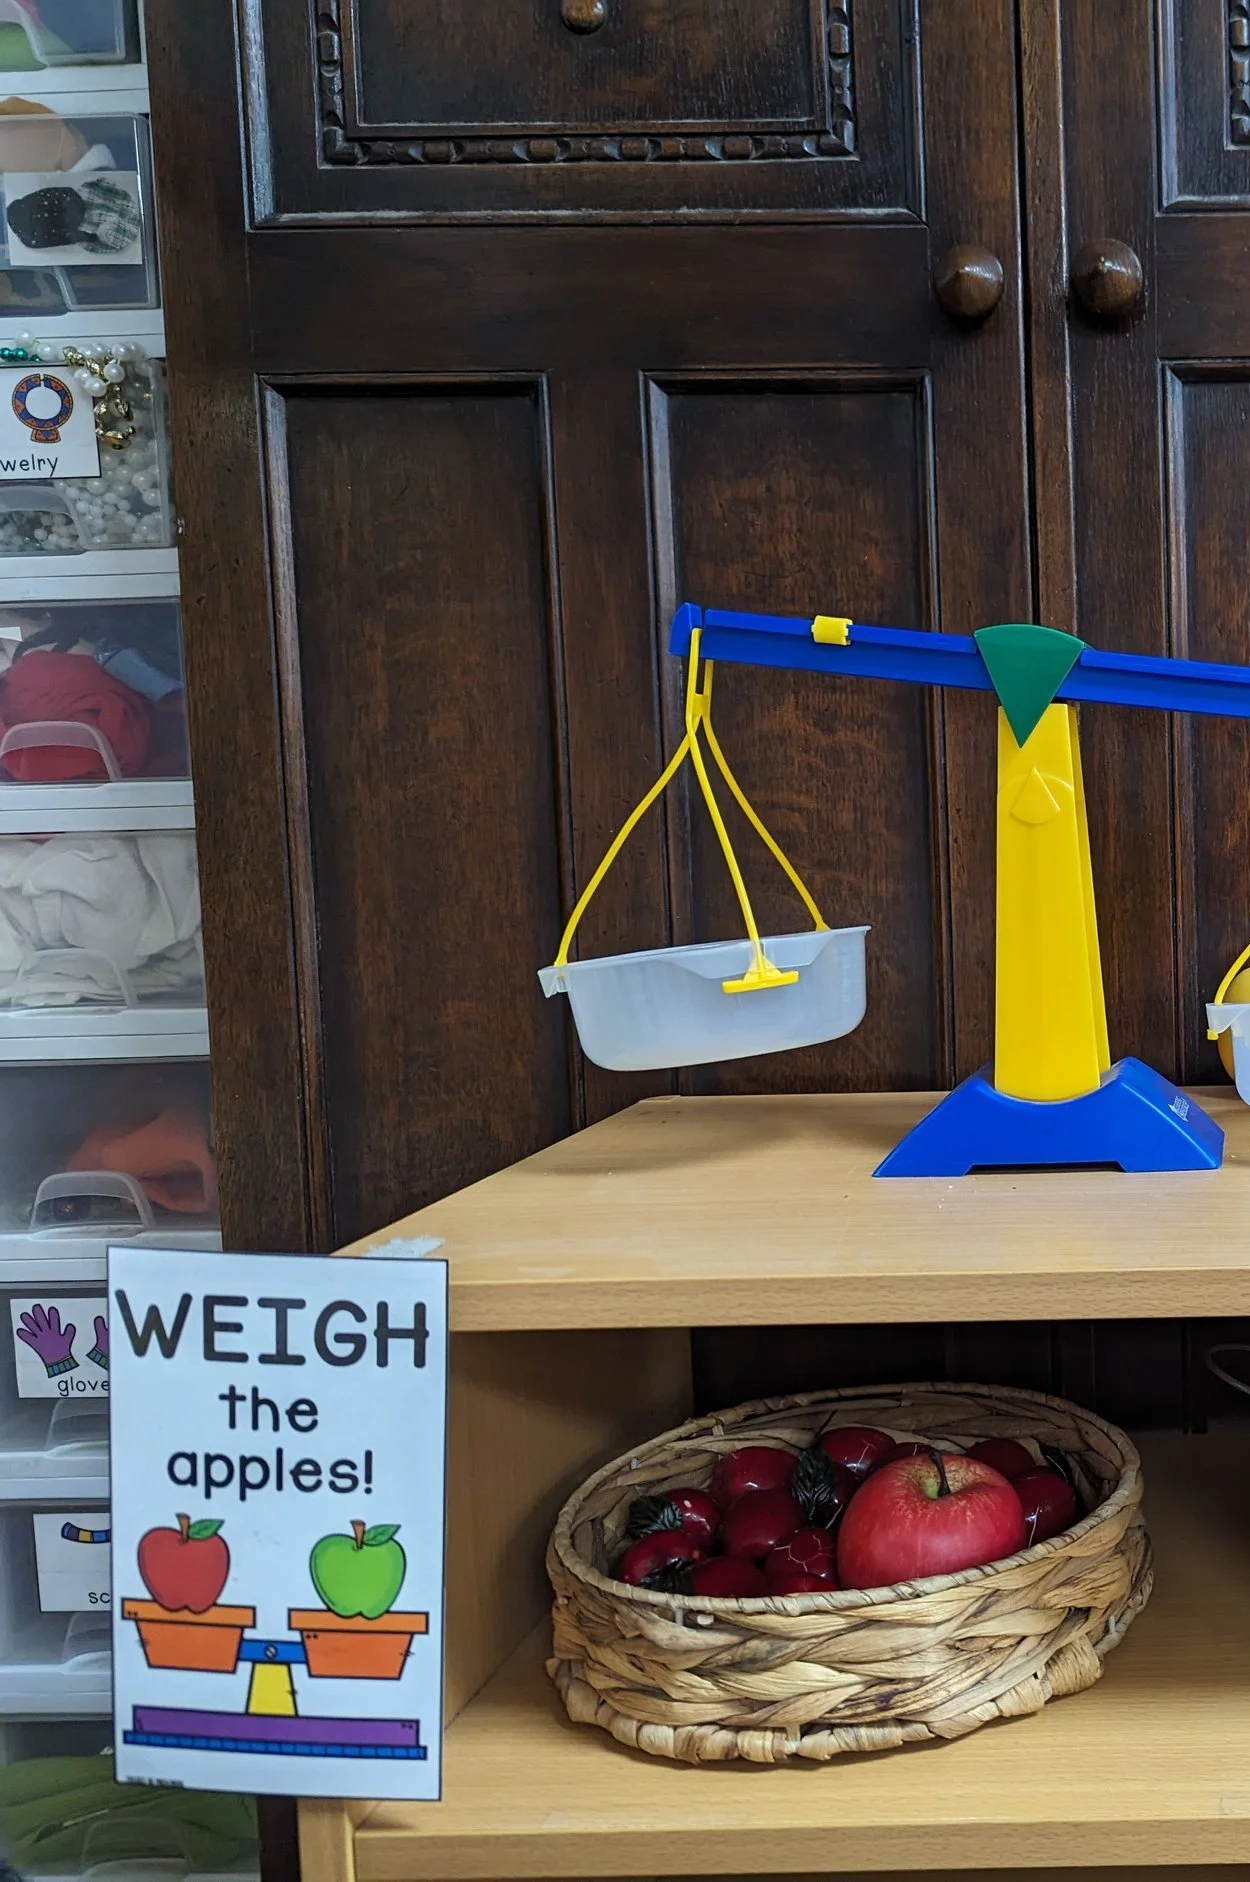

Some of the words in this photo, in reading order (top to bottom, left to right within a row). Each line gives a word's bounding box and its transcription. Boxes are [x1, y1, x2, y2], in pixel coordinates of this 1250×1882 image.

[115, 1289, 429, 1369] WEIGH
[219, 1385, 319, 1432] the
[167, 1448, 374, 1501] apples!
